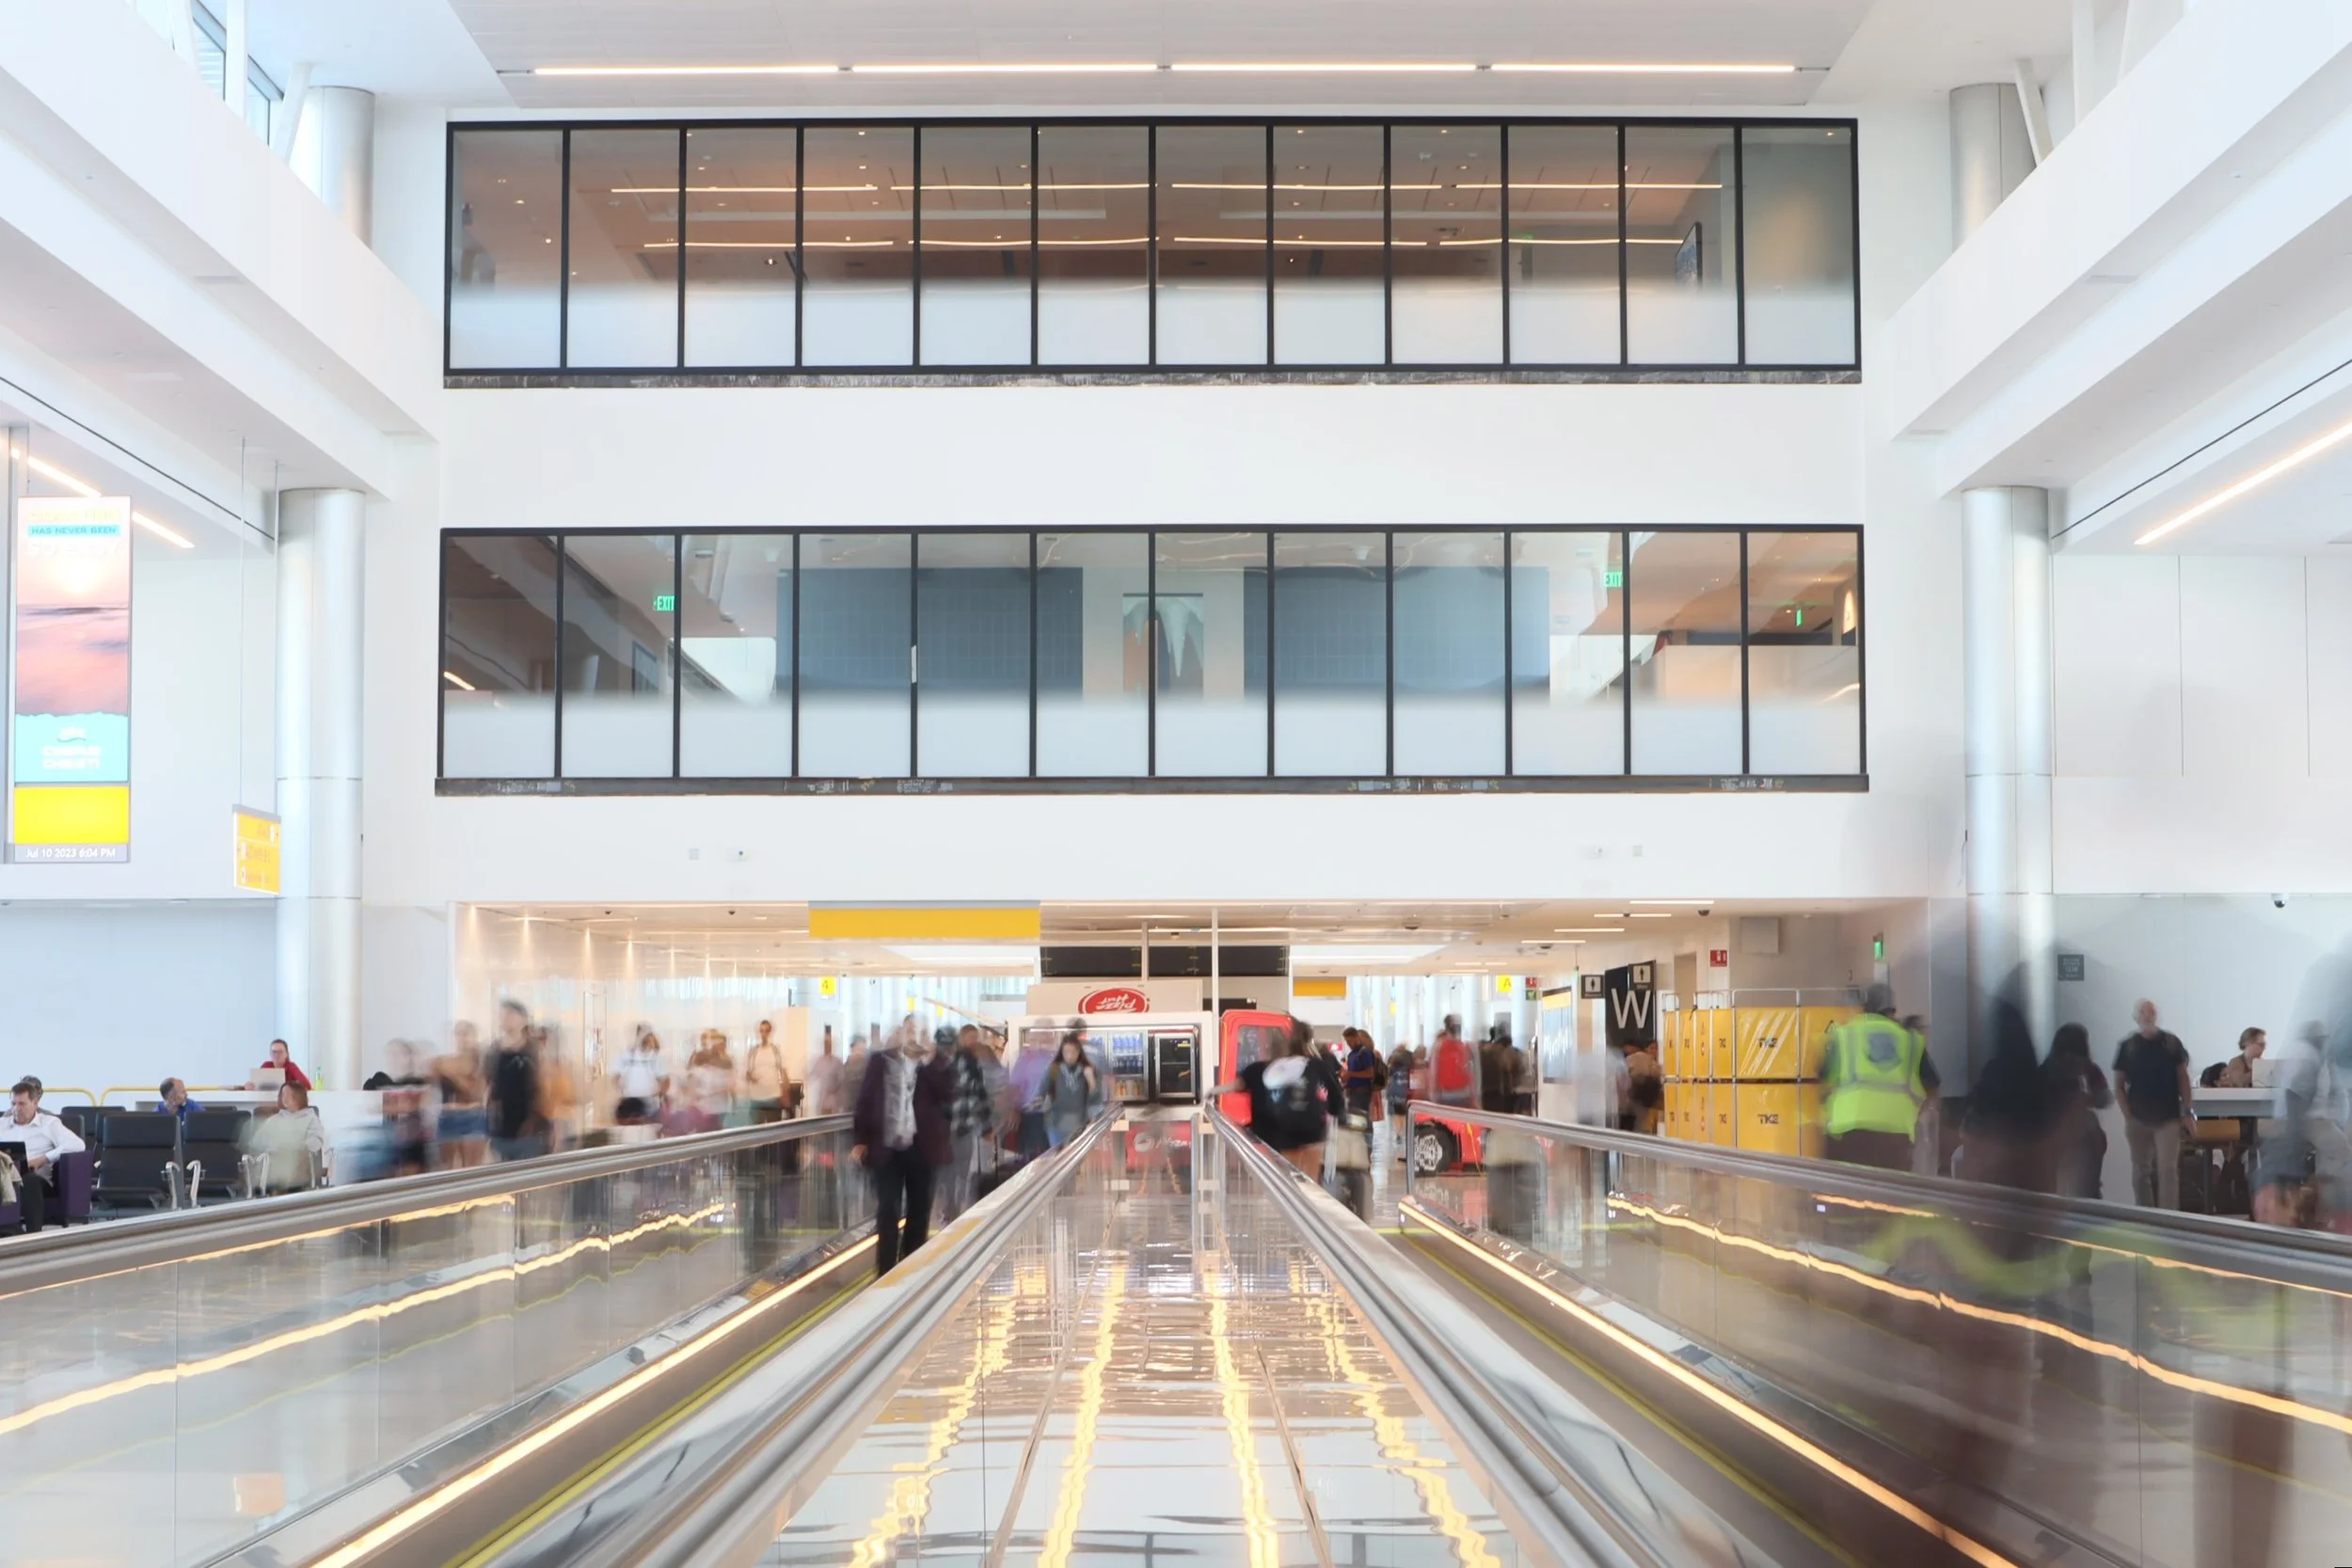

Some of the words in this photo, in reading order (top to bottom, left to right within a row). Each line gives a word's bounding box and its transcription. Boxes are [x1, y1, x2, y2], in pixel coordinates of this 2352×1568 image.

[31, 527, 52, 535] HAS
[657, 594, 675, 611] EXIT
[26, 847, 39, 859] Jul
[41, 847, 53, 859] 10
[55, 847, 76, 859] 2023
[101, 847, 116, 859] PM
[1611, 988, 1651, 1029] W
[1757, 1114, 1779, 1125] TKE
